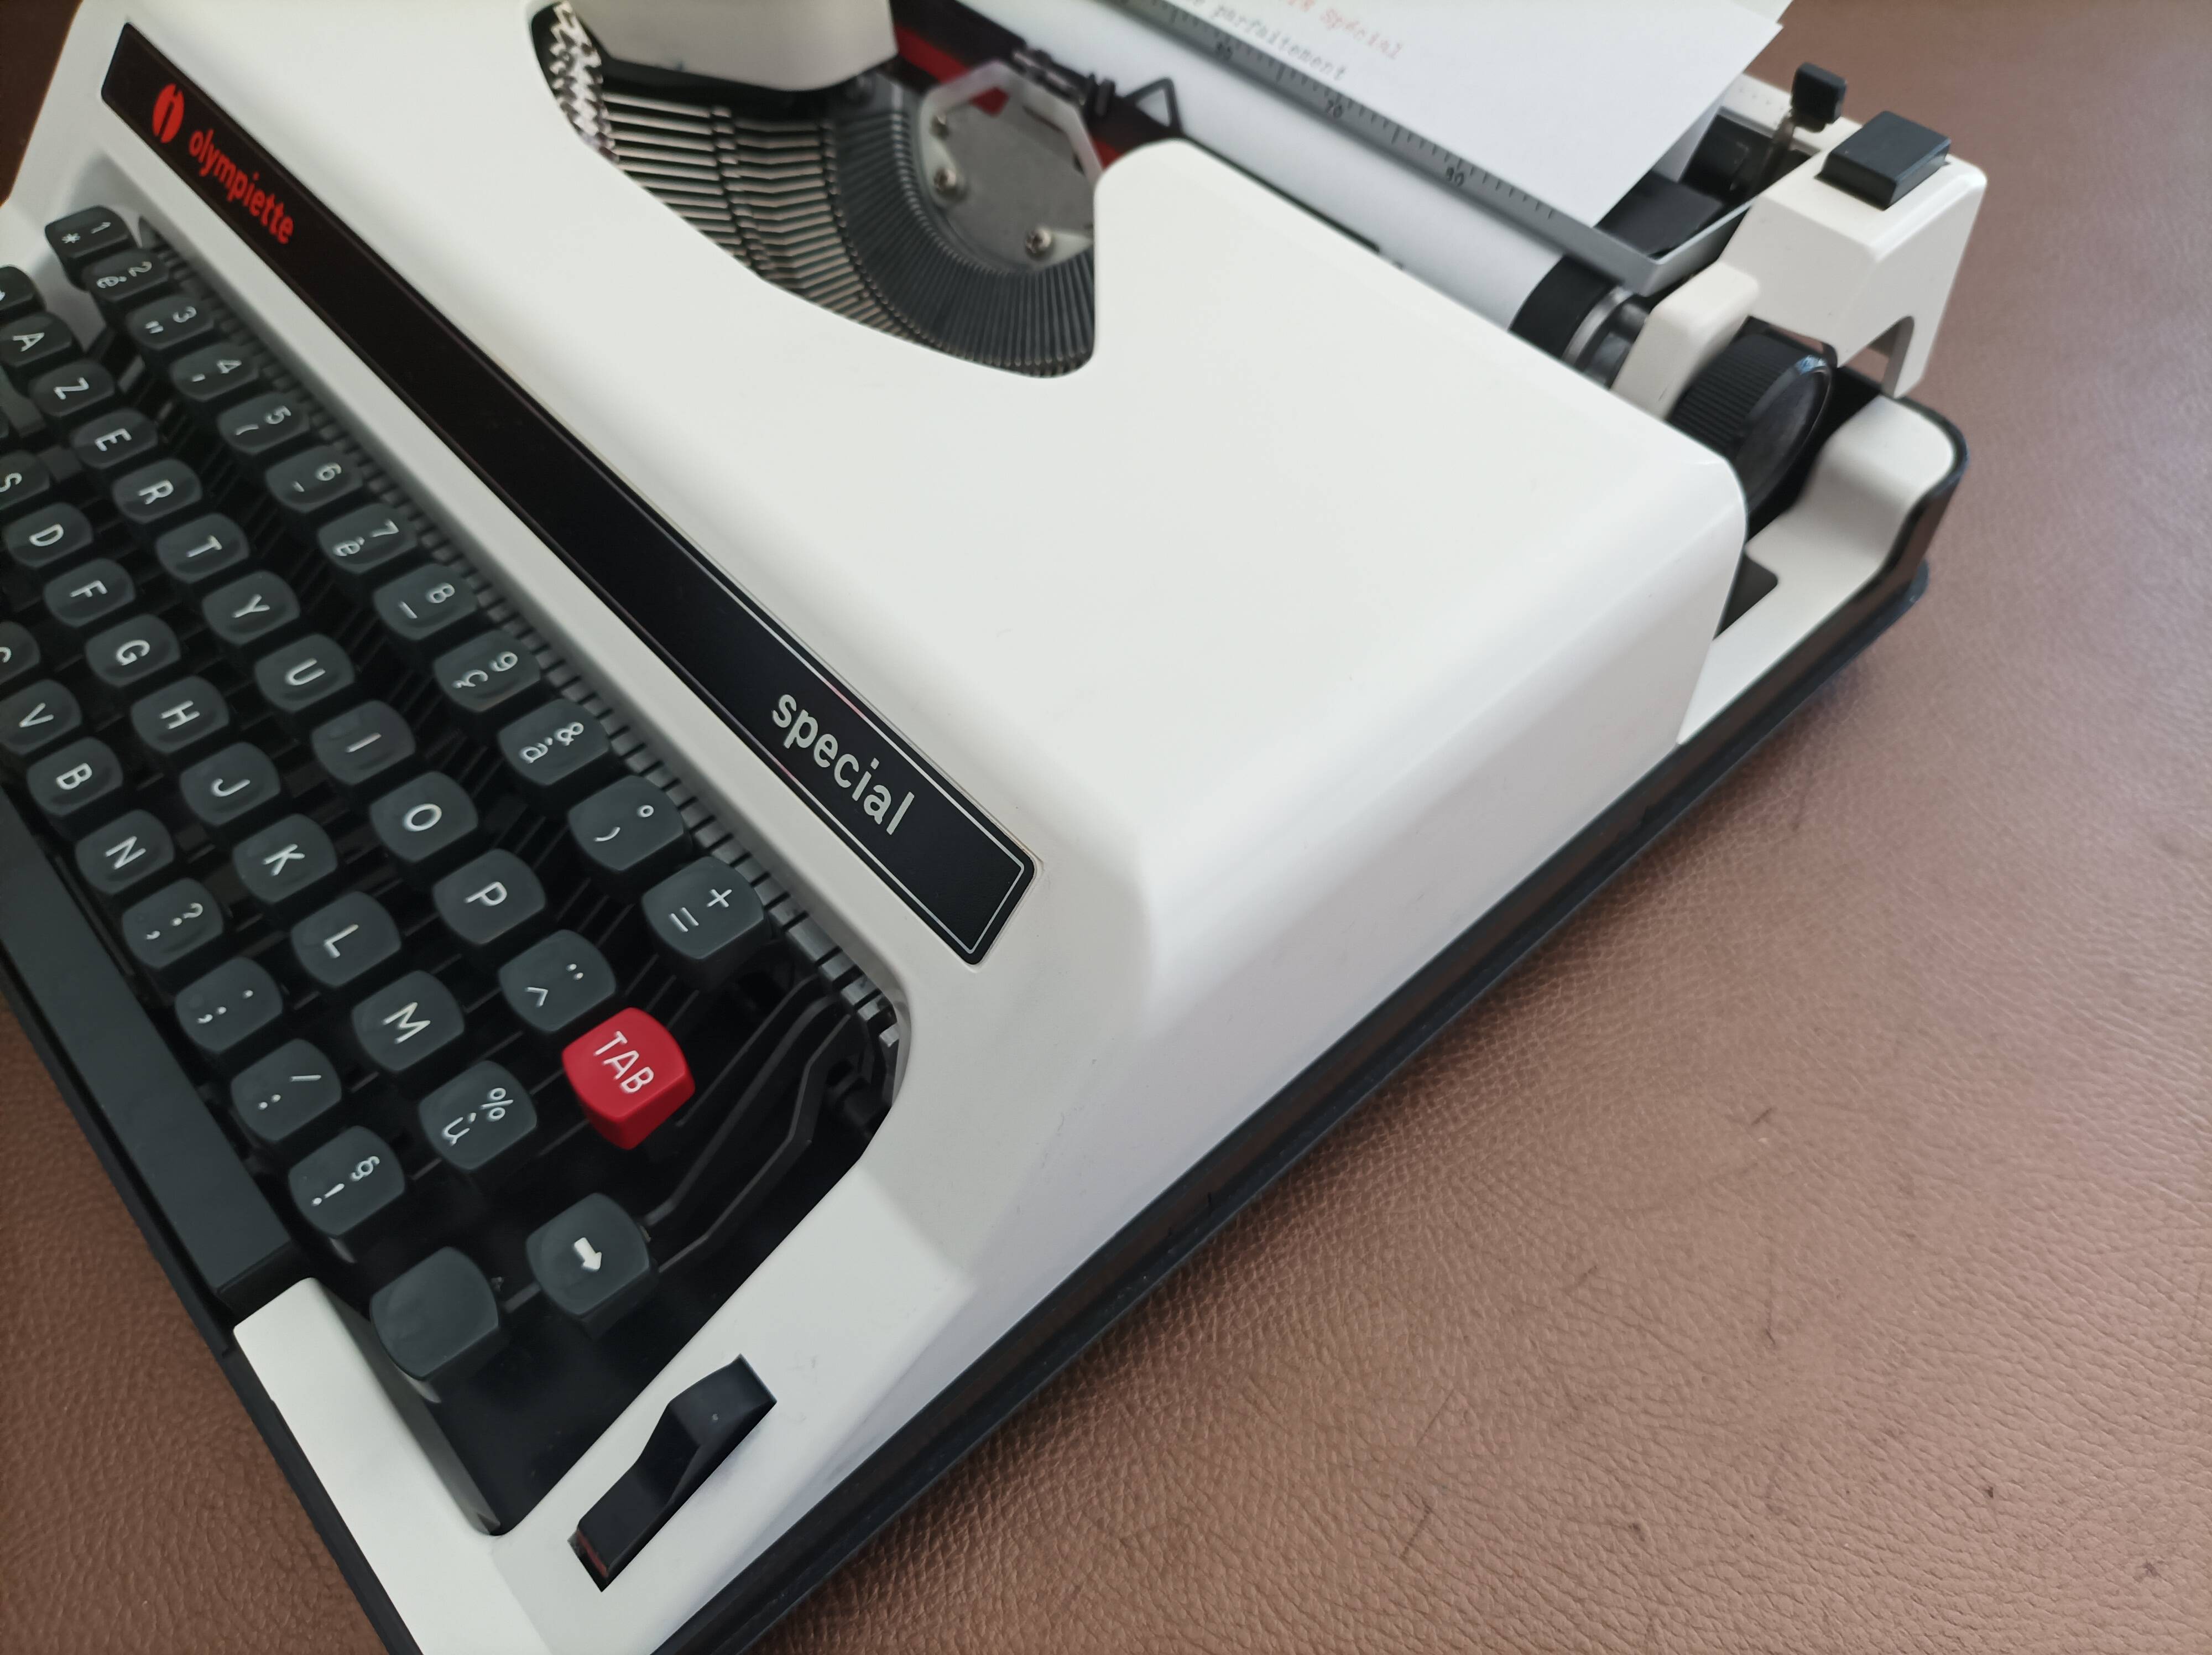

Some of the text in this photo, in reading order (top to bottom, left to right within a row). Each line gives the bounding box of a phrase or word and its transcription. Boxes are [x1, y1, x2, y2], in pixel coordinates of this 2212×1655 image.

[190, 129, 293, 243] olympiette
[128, 261, 152, 277] 2
[97, 277, 127, 288] é
[173, 306, 196, 322] 3
[12, 332, 44, 351] A
[216, 360, 241, 373] 4
[54, 377, 88, 399] Z
[264, 406, 291, 424] 5
[95, 429, 131, 451] E
[316, 464, 341, 481] 6
[138, 480, 173, 504] R
[29, 524, 64, 546] D
[372, 521, 399, 537] 7
[187, 536, 222, 557] T
[333, 537, 364, 556] è
[71, 581, 107, 597] F
[427, 584, 455, 603] 8
[233, 595, 270, 618] Y
[116, 640, 150, 665] G
[491, 652, 518, 672] 9
[285, 659, 325, 685] U
[454, 670, 488, 688] ç
[19, 703, 54, 727] V
[161, 701, 200, 729] H
[555, 722, 583, 746] &
[772, 694, 915, 835] special
[56, 763, 92, 789] B
[211, 779, 250, 797] J
[404, 804, 441, 831] O
[106, 836, 146, 869] N
[264, 844, 305, 876] K
[466, 882, 507, 905] P
[707, 889, 732, 907] +
[172, 903, 203, 926] ?
[324, 925, 358, 957] L
[383, 1002, 430, 1043] M
[594, 1031, 654, 1093] TAB
[481, 1088, 513, 1121] %
[351, 1156, 379, 1181] §
[312, 1184, 345, 1205] !
